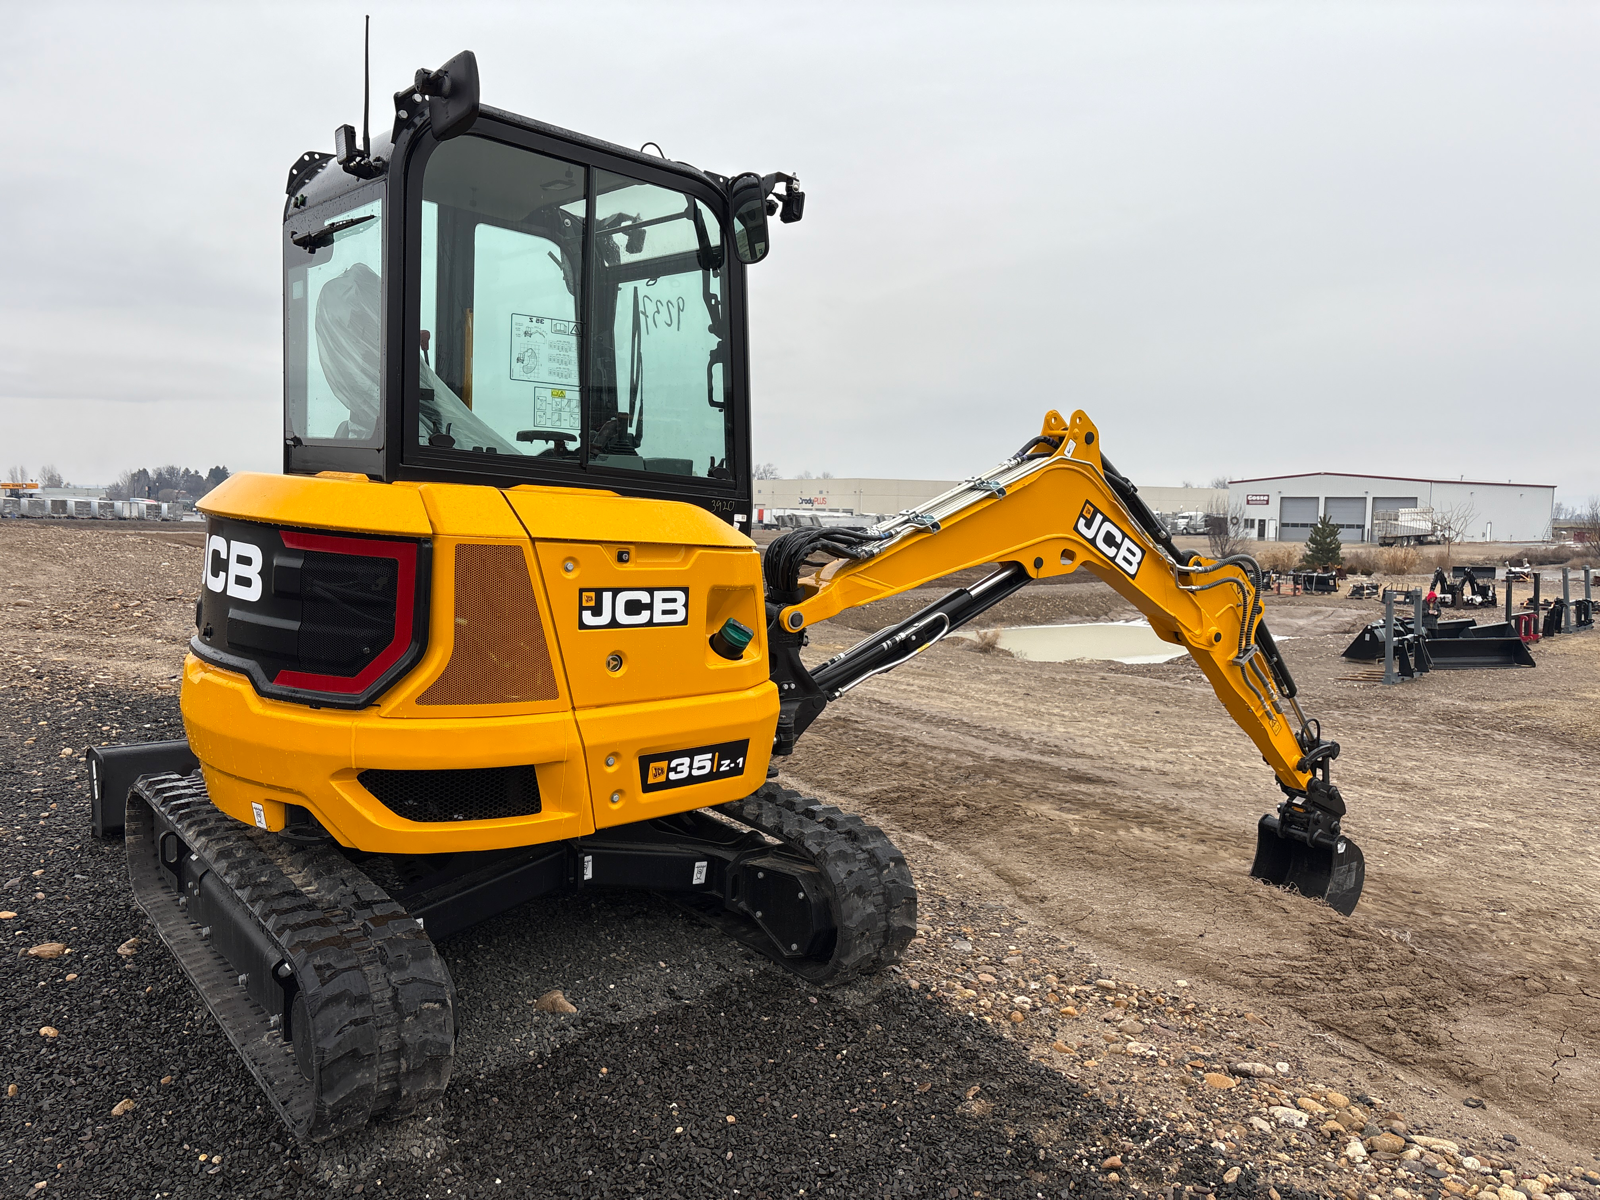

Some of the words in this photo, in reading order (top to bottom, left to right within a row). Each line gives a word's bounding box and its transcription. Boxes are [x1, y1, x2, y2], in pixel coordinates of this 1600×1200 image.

[1077, 512, 1143, 575] JCB
[581, 590, 686, 626] JCB
[668, 753, 713, 780] 35
